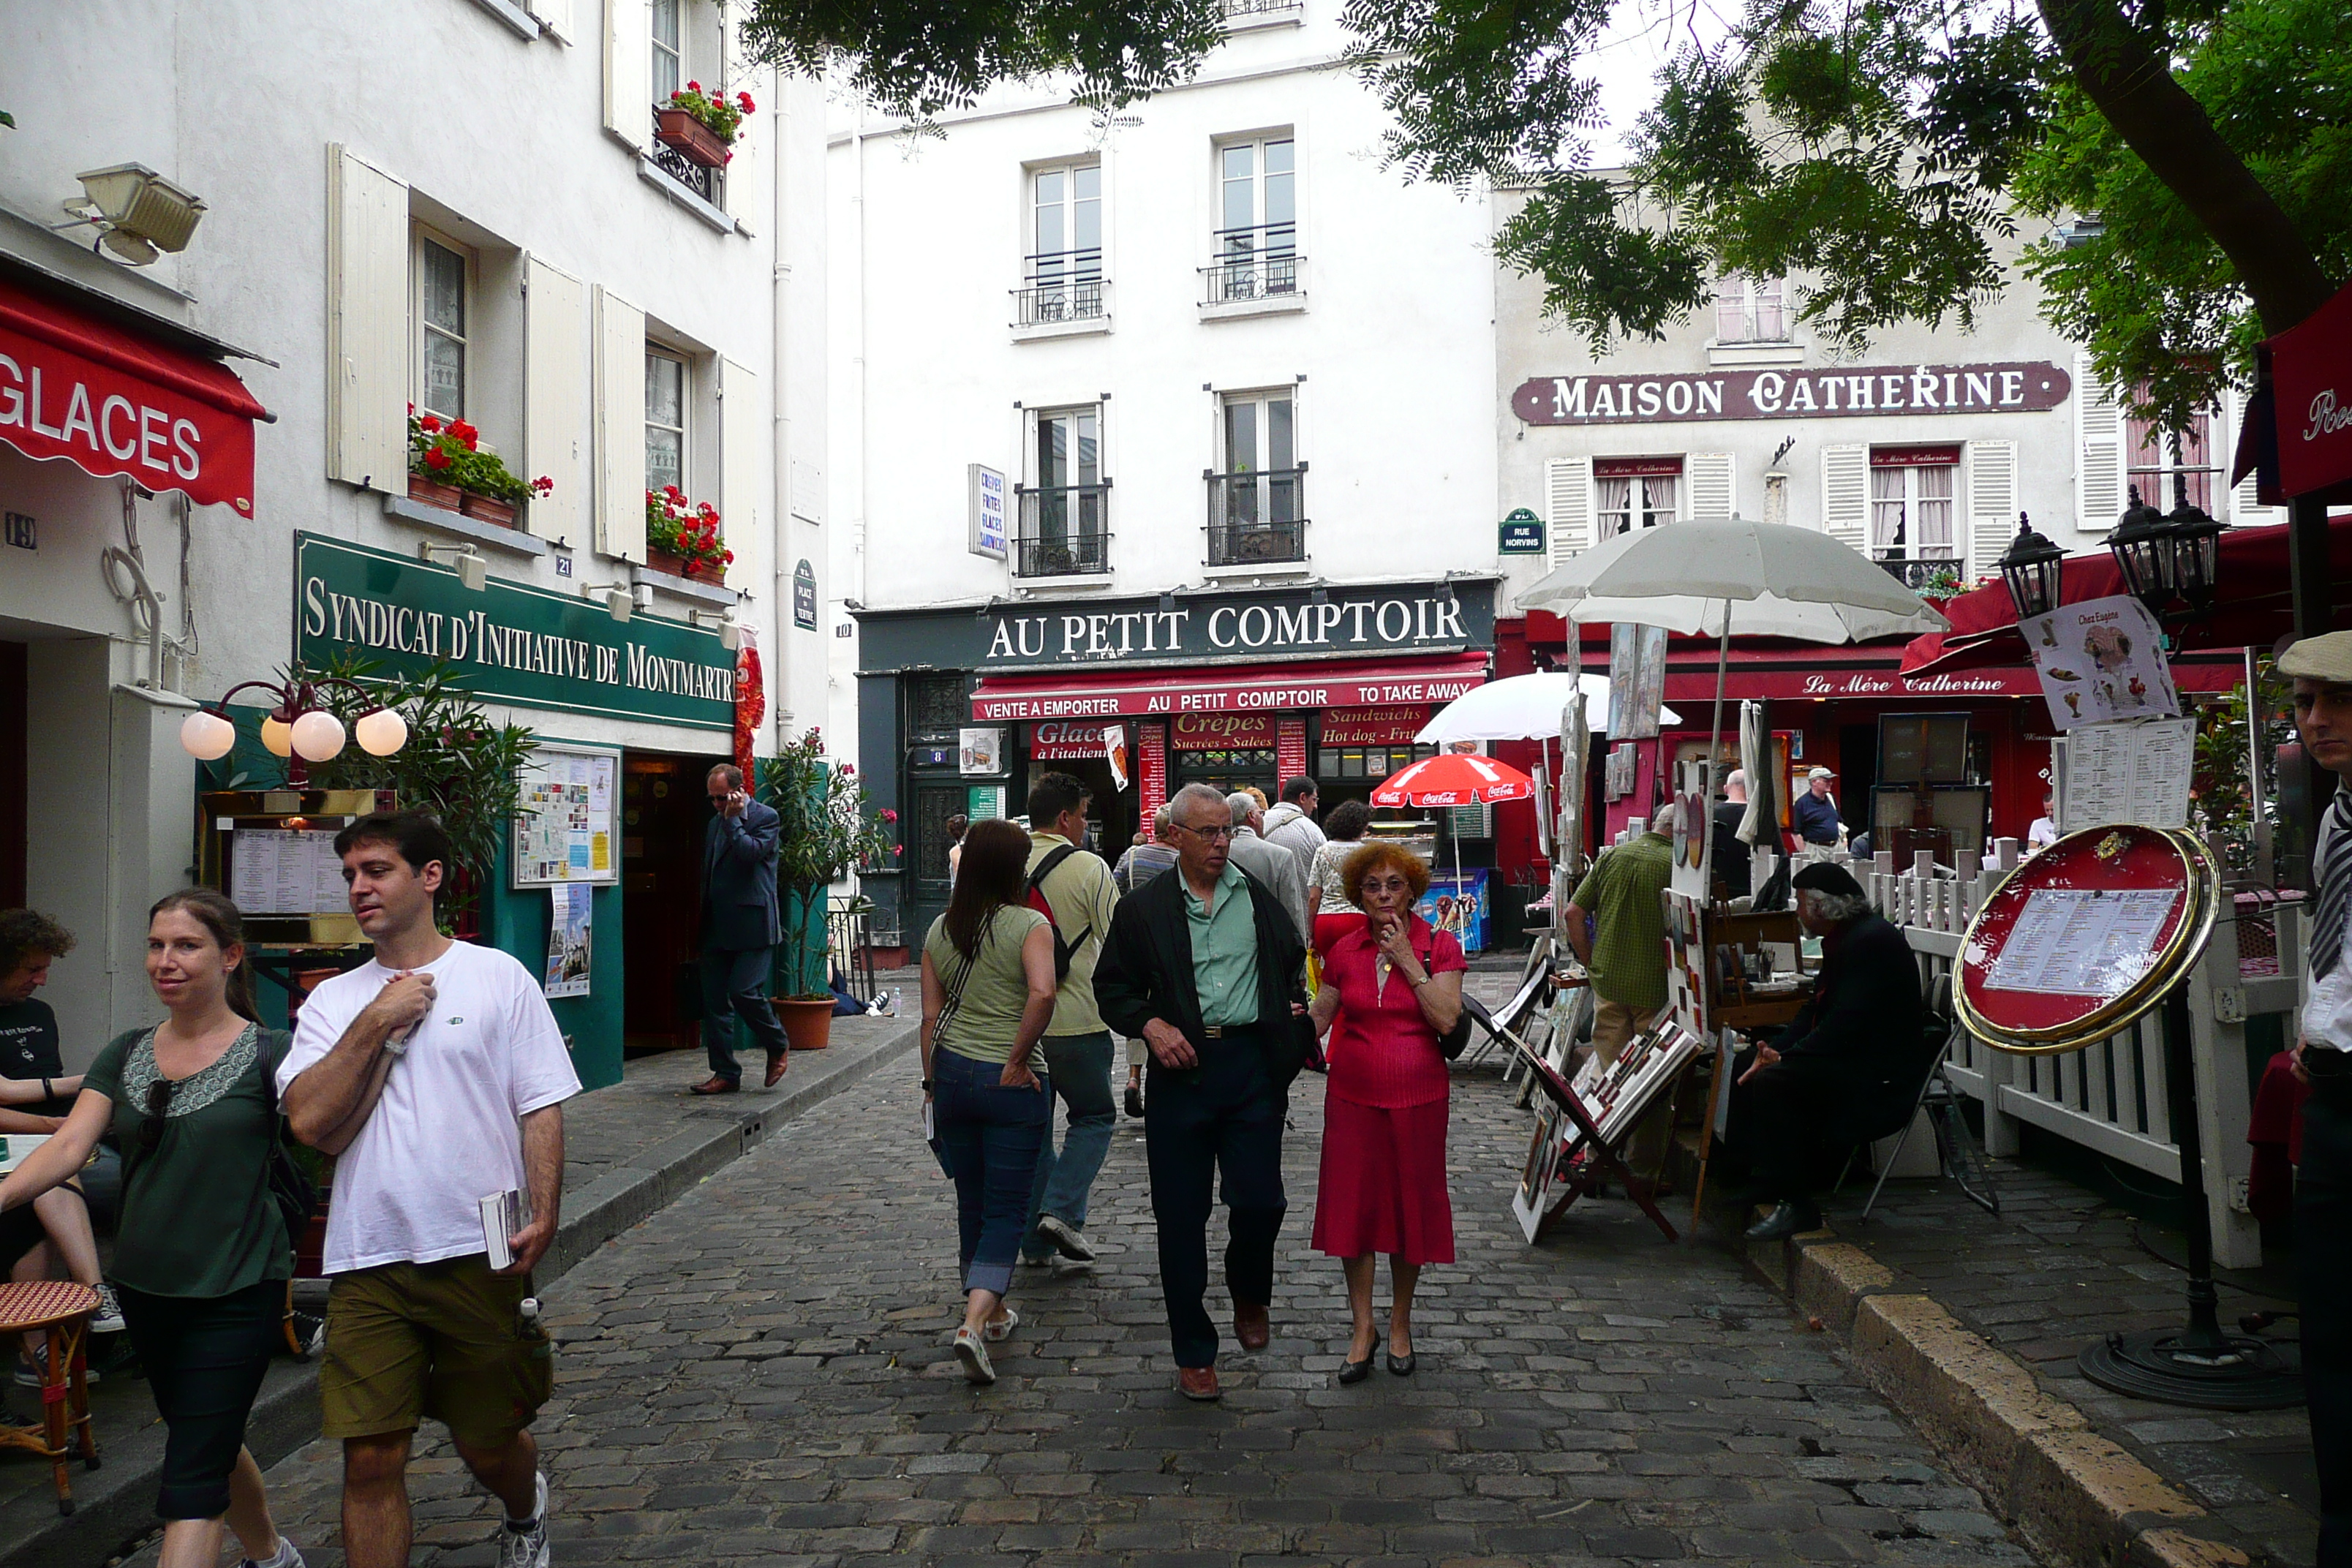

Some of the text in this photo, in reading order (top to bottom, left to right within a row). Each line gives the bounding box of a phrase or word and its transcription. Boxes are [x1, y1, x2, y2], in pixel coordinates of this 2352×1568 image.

[1552, 371, 2024, 418] MAISON CATHERINE
[0, 353, 201, 480] GLACES
[982, 493, 1001, 513] FRITES
[9, 513, 36, 548] 19
[982, 513, 1002, 532] GLACES
[559, 558, 569, 574] 21
[798, 586, 812, 599] PLACE
[986, 598, 1468, 658] AU PETIT COMPTOIR
[2078, 614, 2095, 625] Chez
[304, 576, 445, 656] SYNDICAT
[595, 644, 620, 685] DE
[837, 624, 850, 637] 10
[1803, 676, 1833, 693] La
[1902, 674, 2007, 692] Catherine
[984, 683, 1470, 718] VENTE A EMPORTER AU PETIT COMPTOIR TO TAKE AWAY
[1329, 707, 1421, 723] Sandwichs
[1037, 723, 1107, 744] Glace
[1172, 737, 1220, 749] Sucrées
[1232, 736, 1273, 747] Salées
[1322, 729, 1348, 743] Hot
[1352, 728, 1376, 744] dog
[1389, 726, 1419, 740] Frit
[2023, 733, 2054, 741] Maiso
[935, 752, 941, 762] 8
[1038, 747, 1109, 759] à l'italienn
